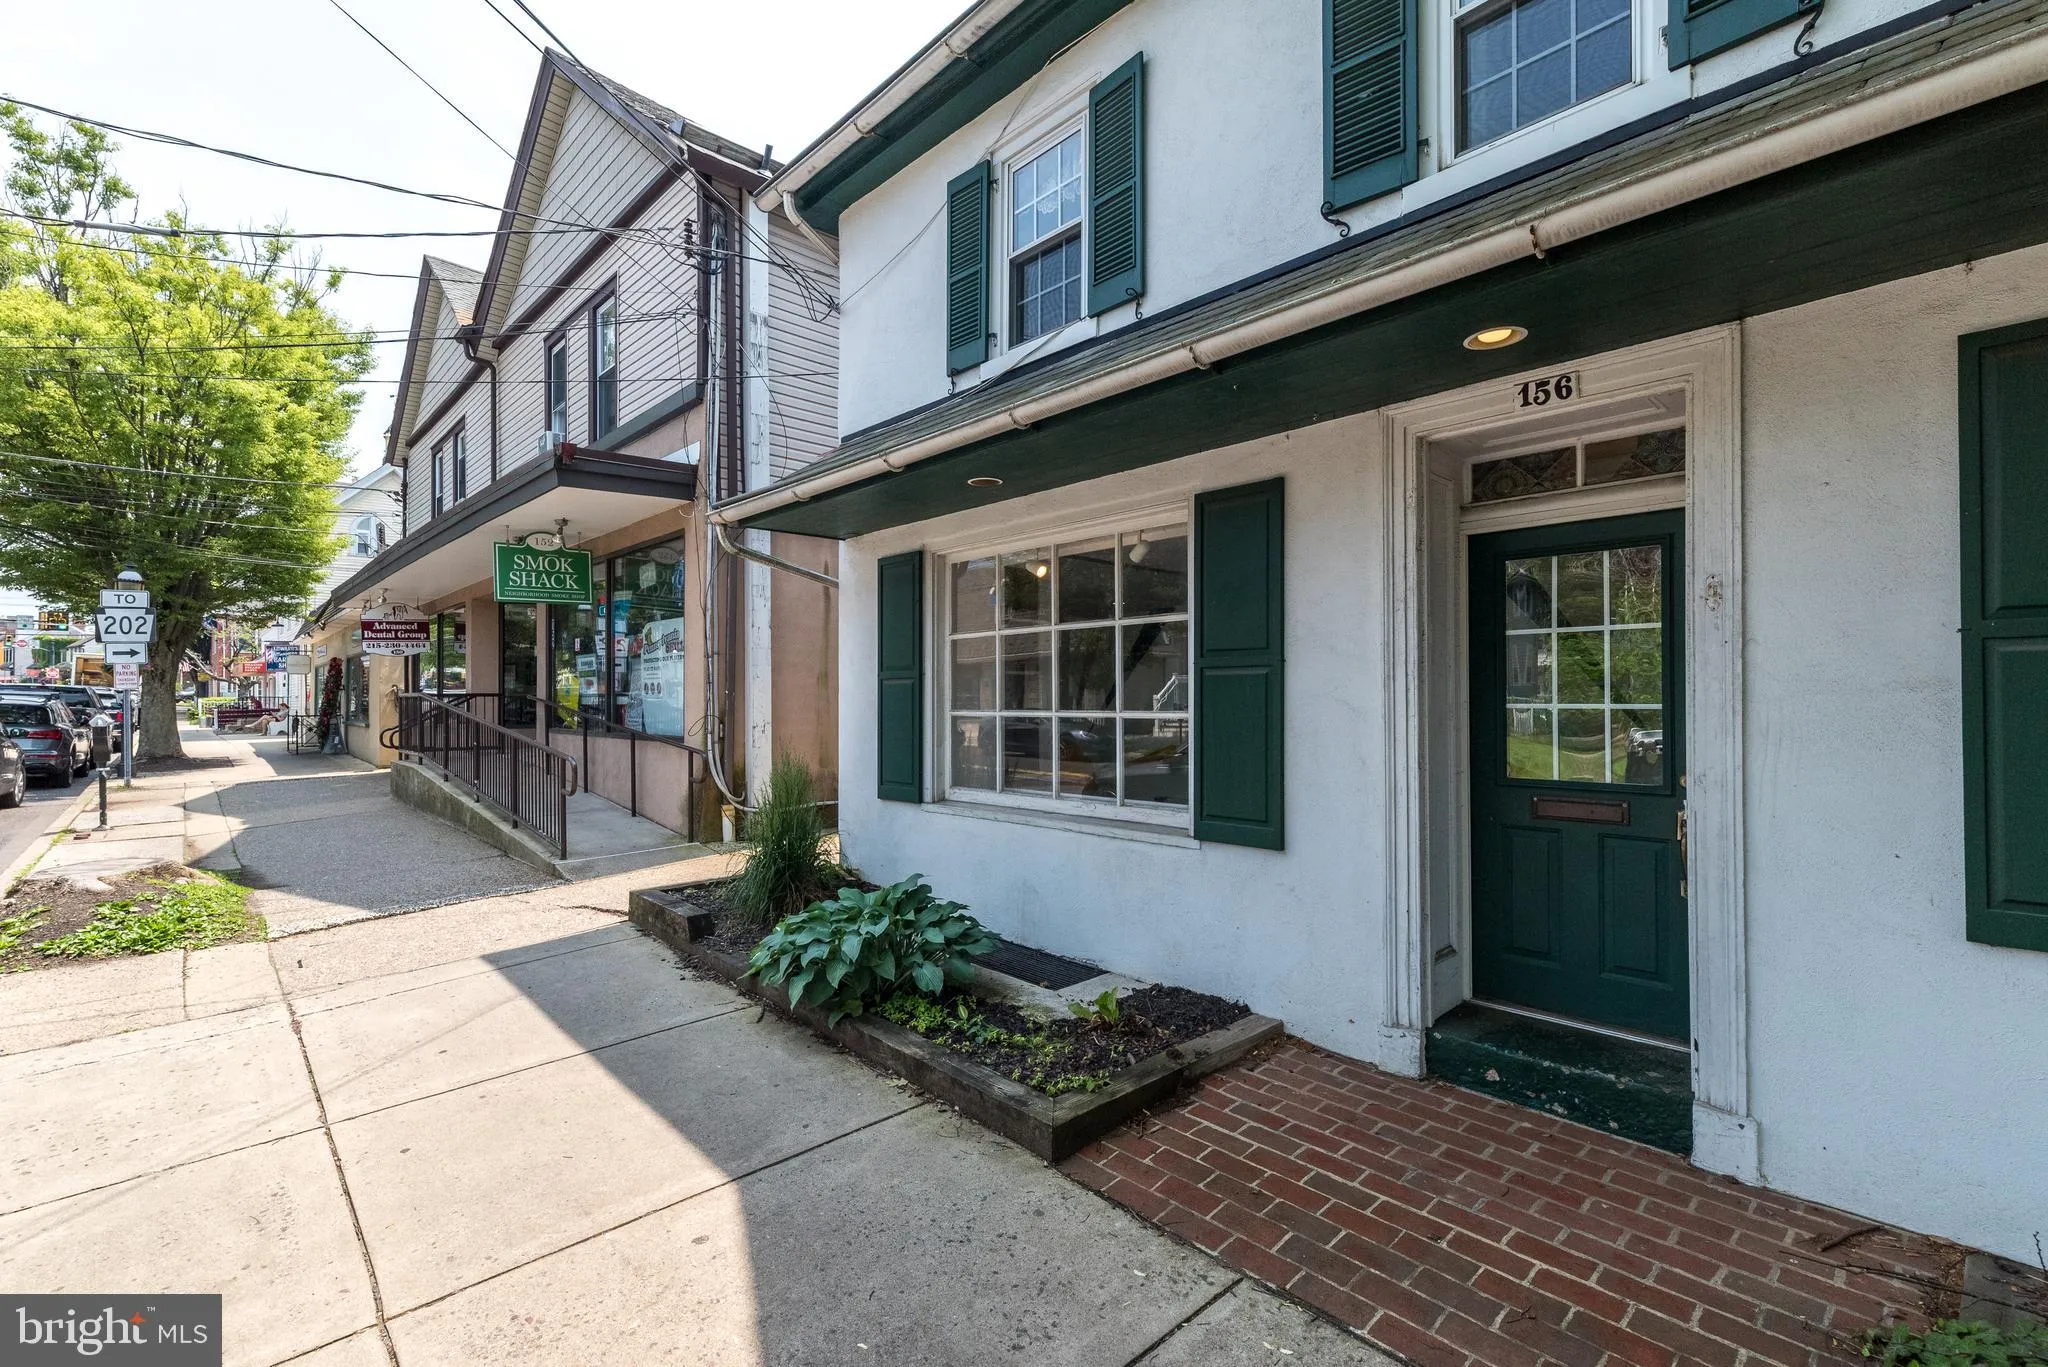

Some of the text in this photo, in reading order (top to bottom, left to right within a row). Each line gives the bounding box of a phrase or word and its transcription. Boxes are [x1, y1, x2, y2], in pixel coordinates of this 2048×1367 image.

[1517, 375, 1573, 408] 156
[535, 537, 554, 547] 152
[509, 570, 579, 590] SHACK
[113, 594, 136, 604] TO
[104, 616, 148, 635] 202
[372, 622, 418, 630] Advanced
[363, 630, 427, 640] Dental Group
